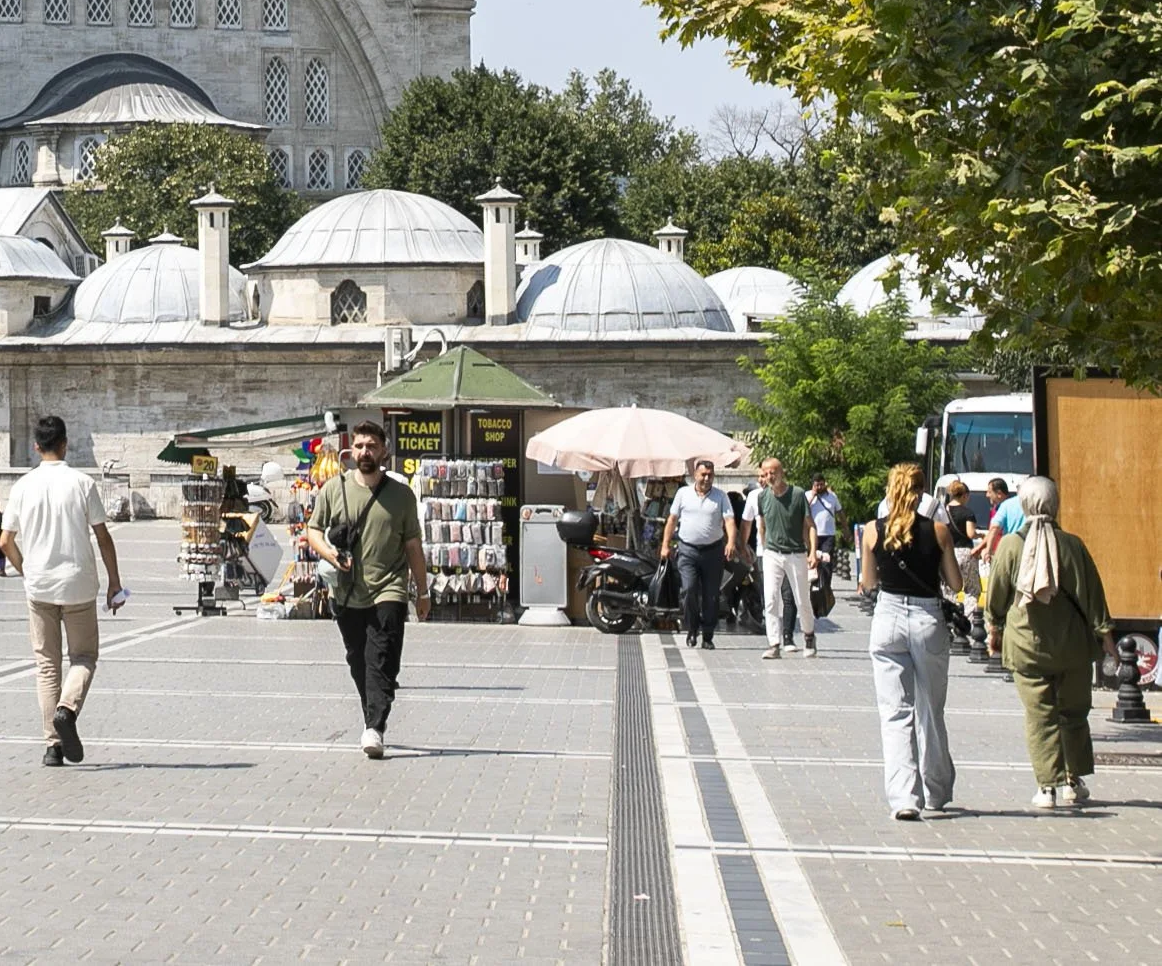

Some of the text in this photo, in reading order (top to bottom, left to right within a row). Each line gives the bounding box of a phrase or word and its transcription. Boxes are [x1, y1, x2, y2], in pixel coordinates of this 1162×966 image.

[398, 421, 441, 434] TRAM
[477, 418, 512, 429] TOBACCO
[484, 431, 506, 442] SHOP
[398, 437, 441, 450] TICKET
[203, 460, 214, 471] 20
